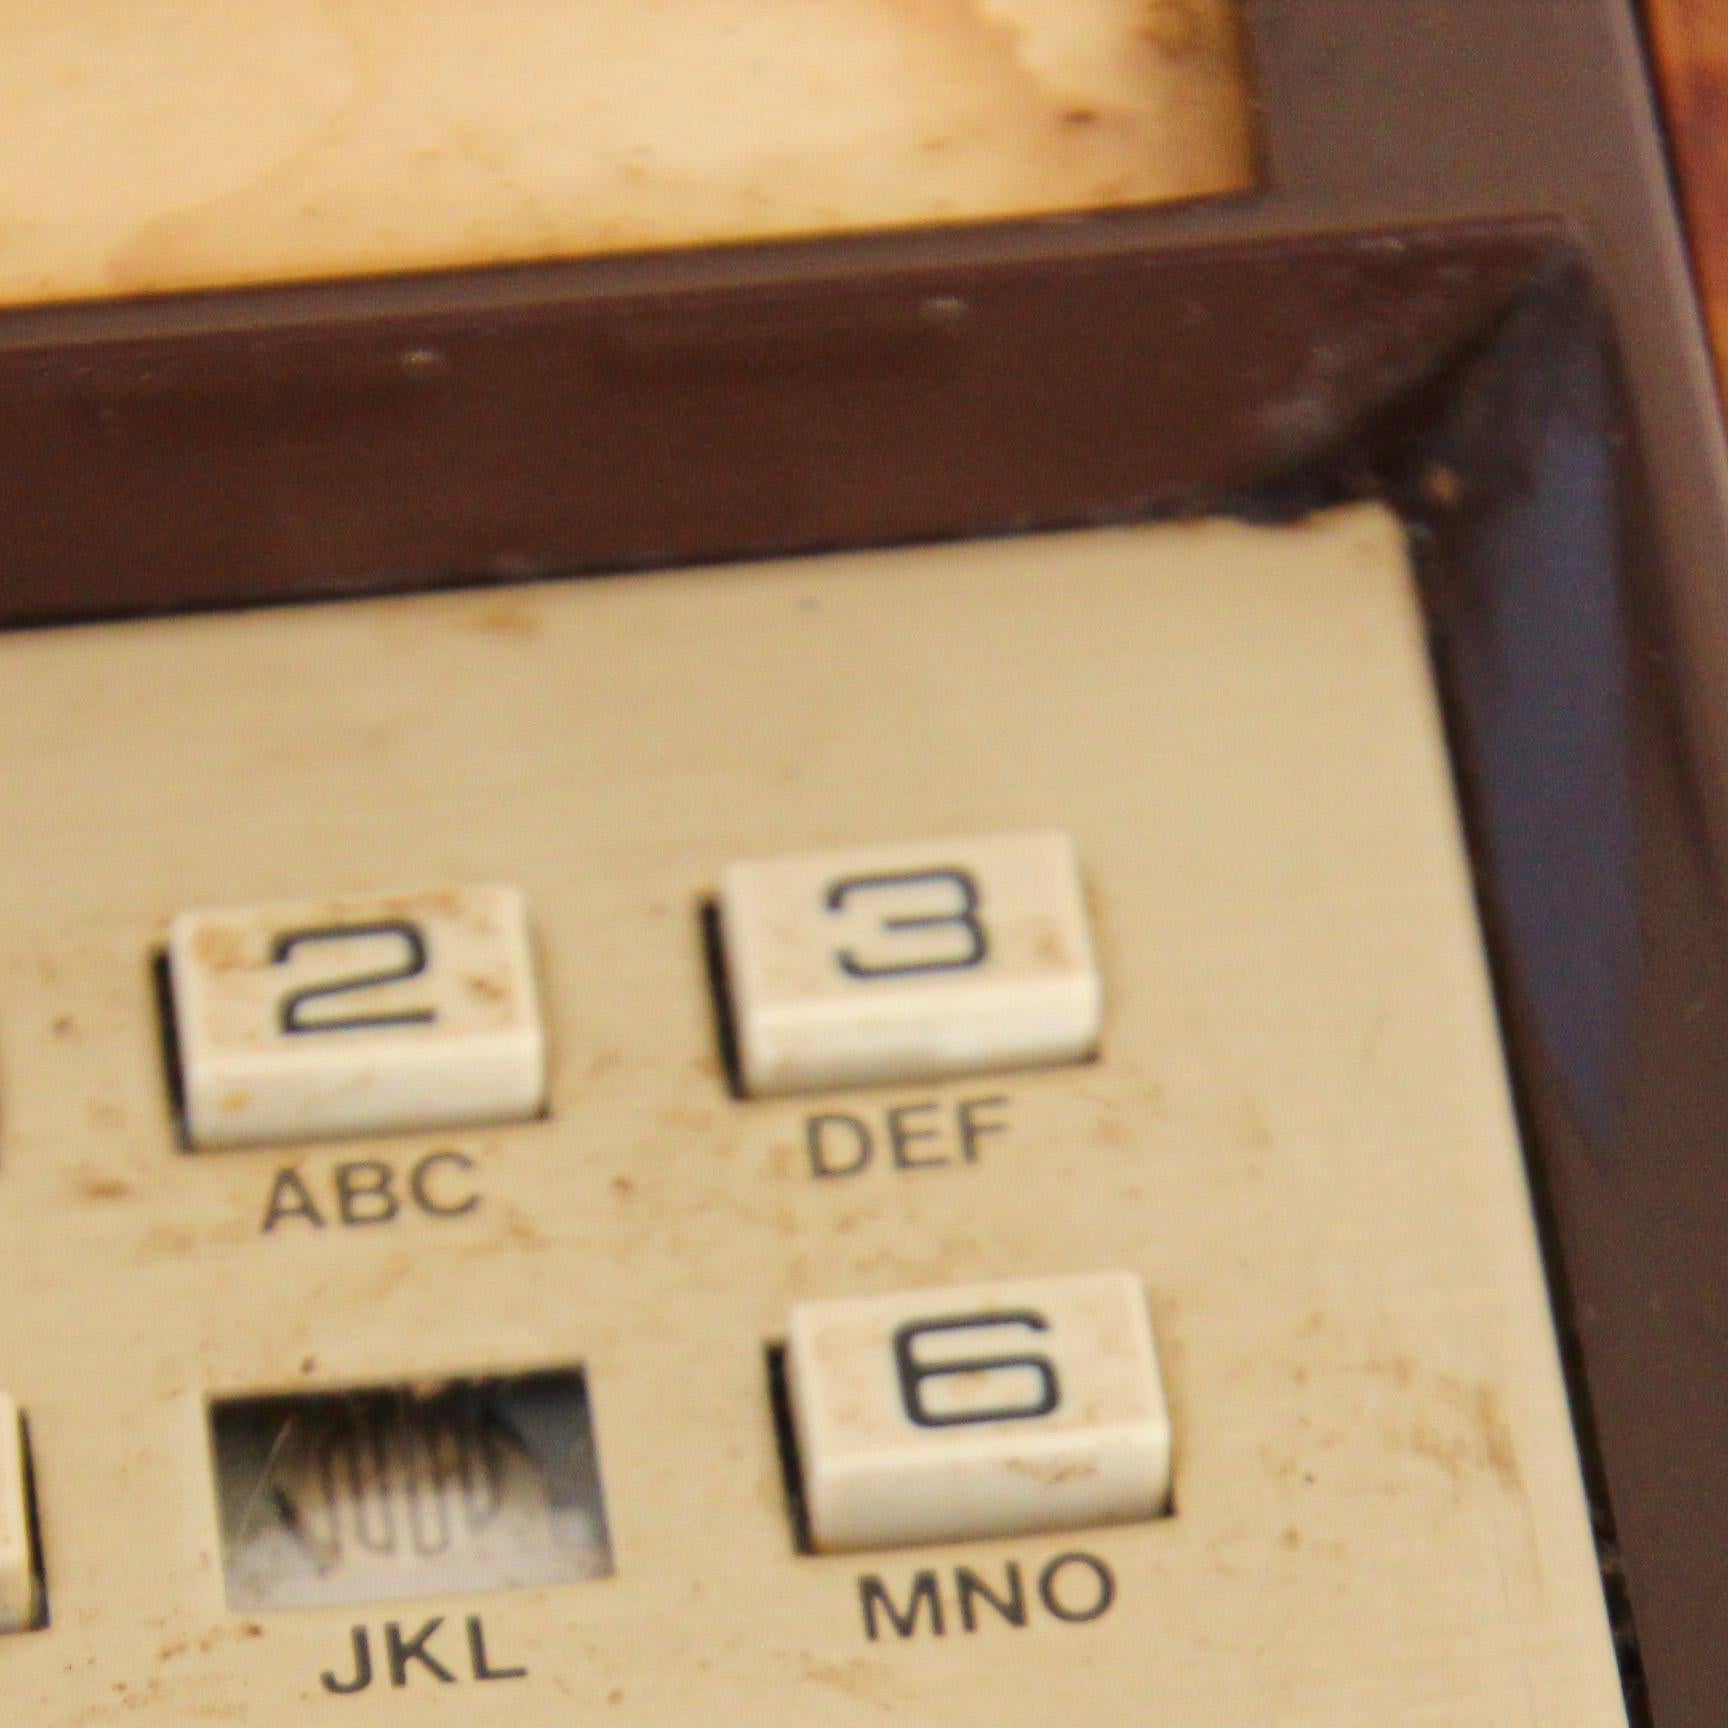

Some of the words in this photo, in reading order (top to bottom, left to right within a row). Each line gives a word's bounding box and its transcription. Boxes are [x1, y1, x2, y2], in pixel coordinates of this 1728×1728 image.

[823, 866, 991, 981] 3
[267, 915, 436, 1036] 2
[806, 1097, 1010, 1179] DEF
[258, 1151, 483, 1236] ABC
[891, 1310, 1062, 1429] 6
[857, 1550, 1116, 1643] MNO
[320, 1616, 527, 1695] JKL
